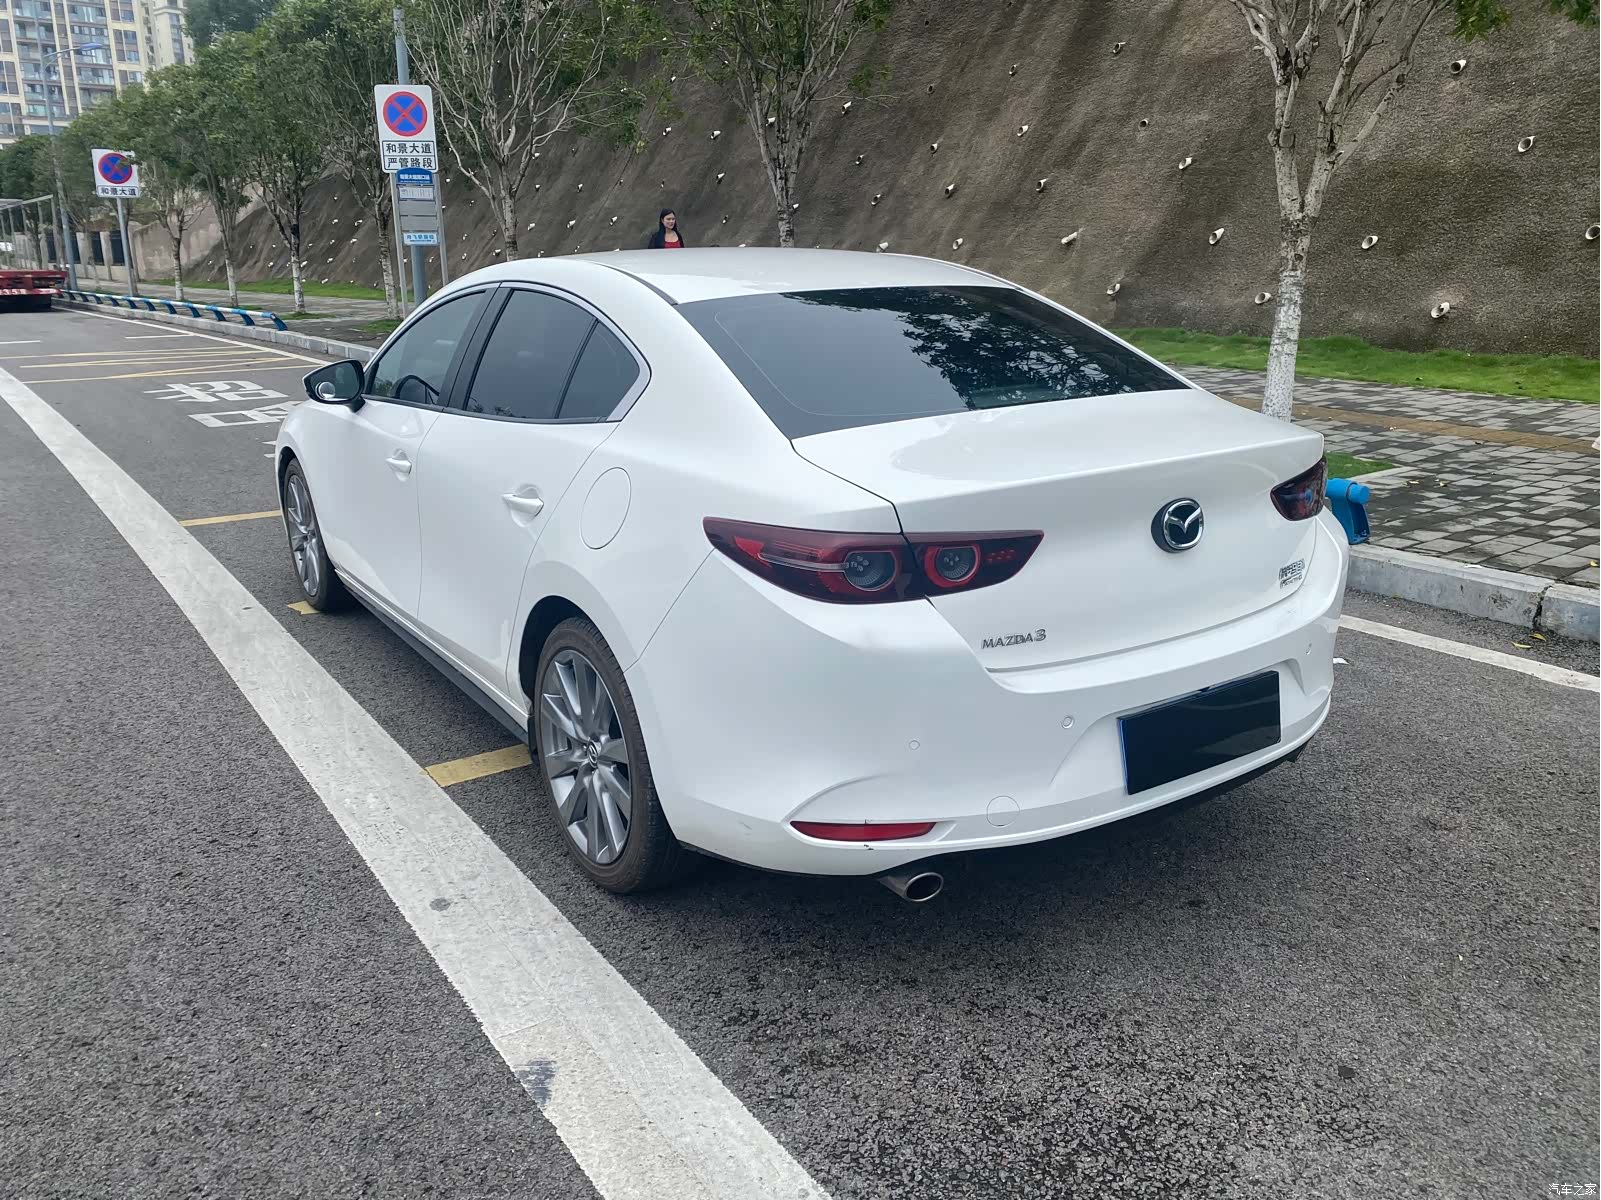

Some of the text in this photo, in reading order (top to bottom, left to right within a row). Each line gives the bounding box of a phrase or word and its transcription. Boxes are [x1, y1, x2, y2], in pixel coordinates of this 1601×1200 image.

[386, 143, 431, 154] 和景大道
[387, 157, 433, 168] 严管路段
